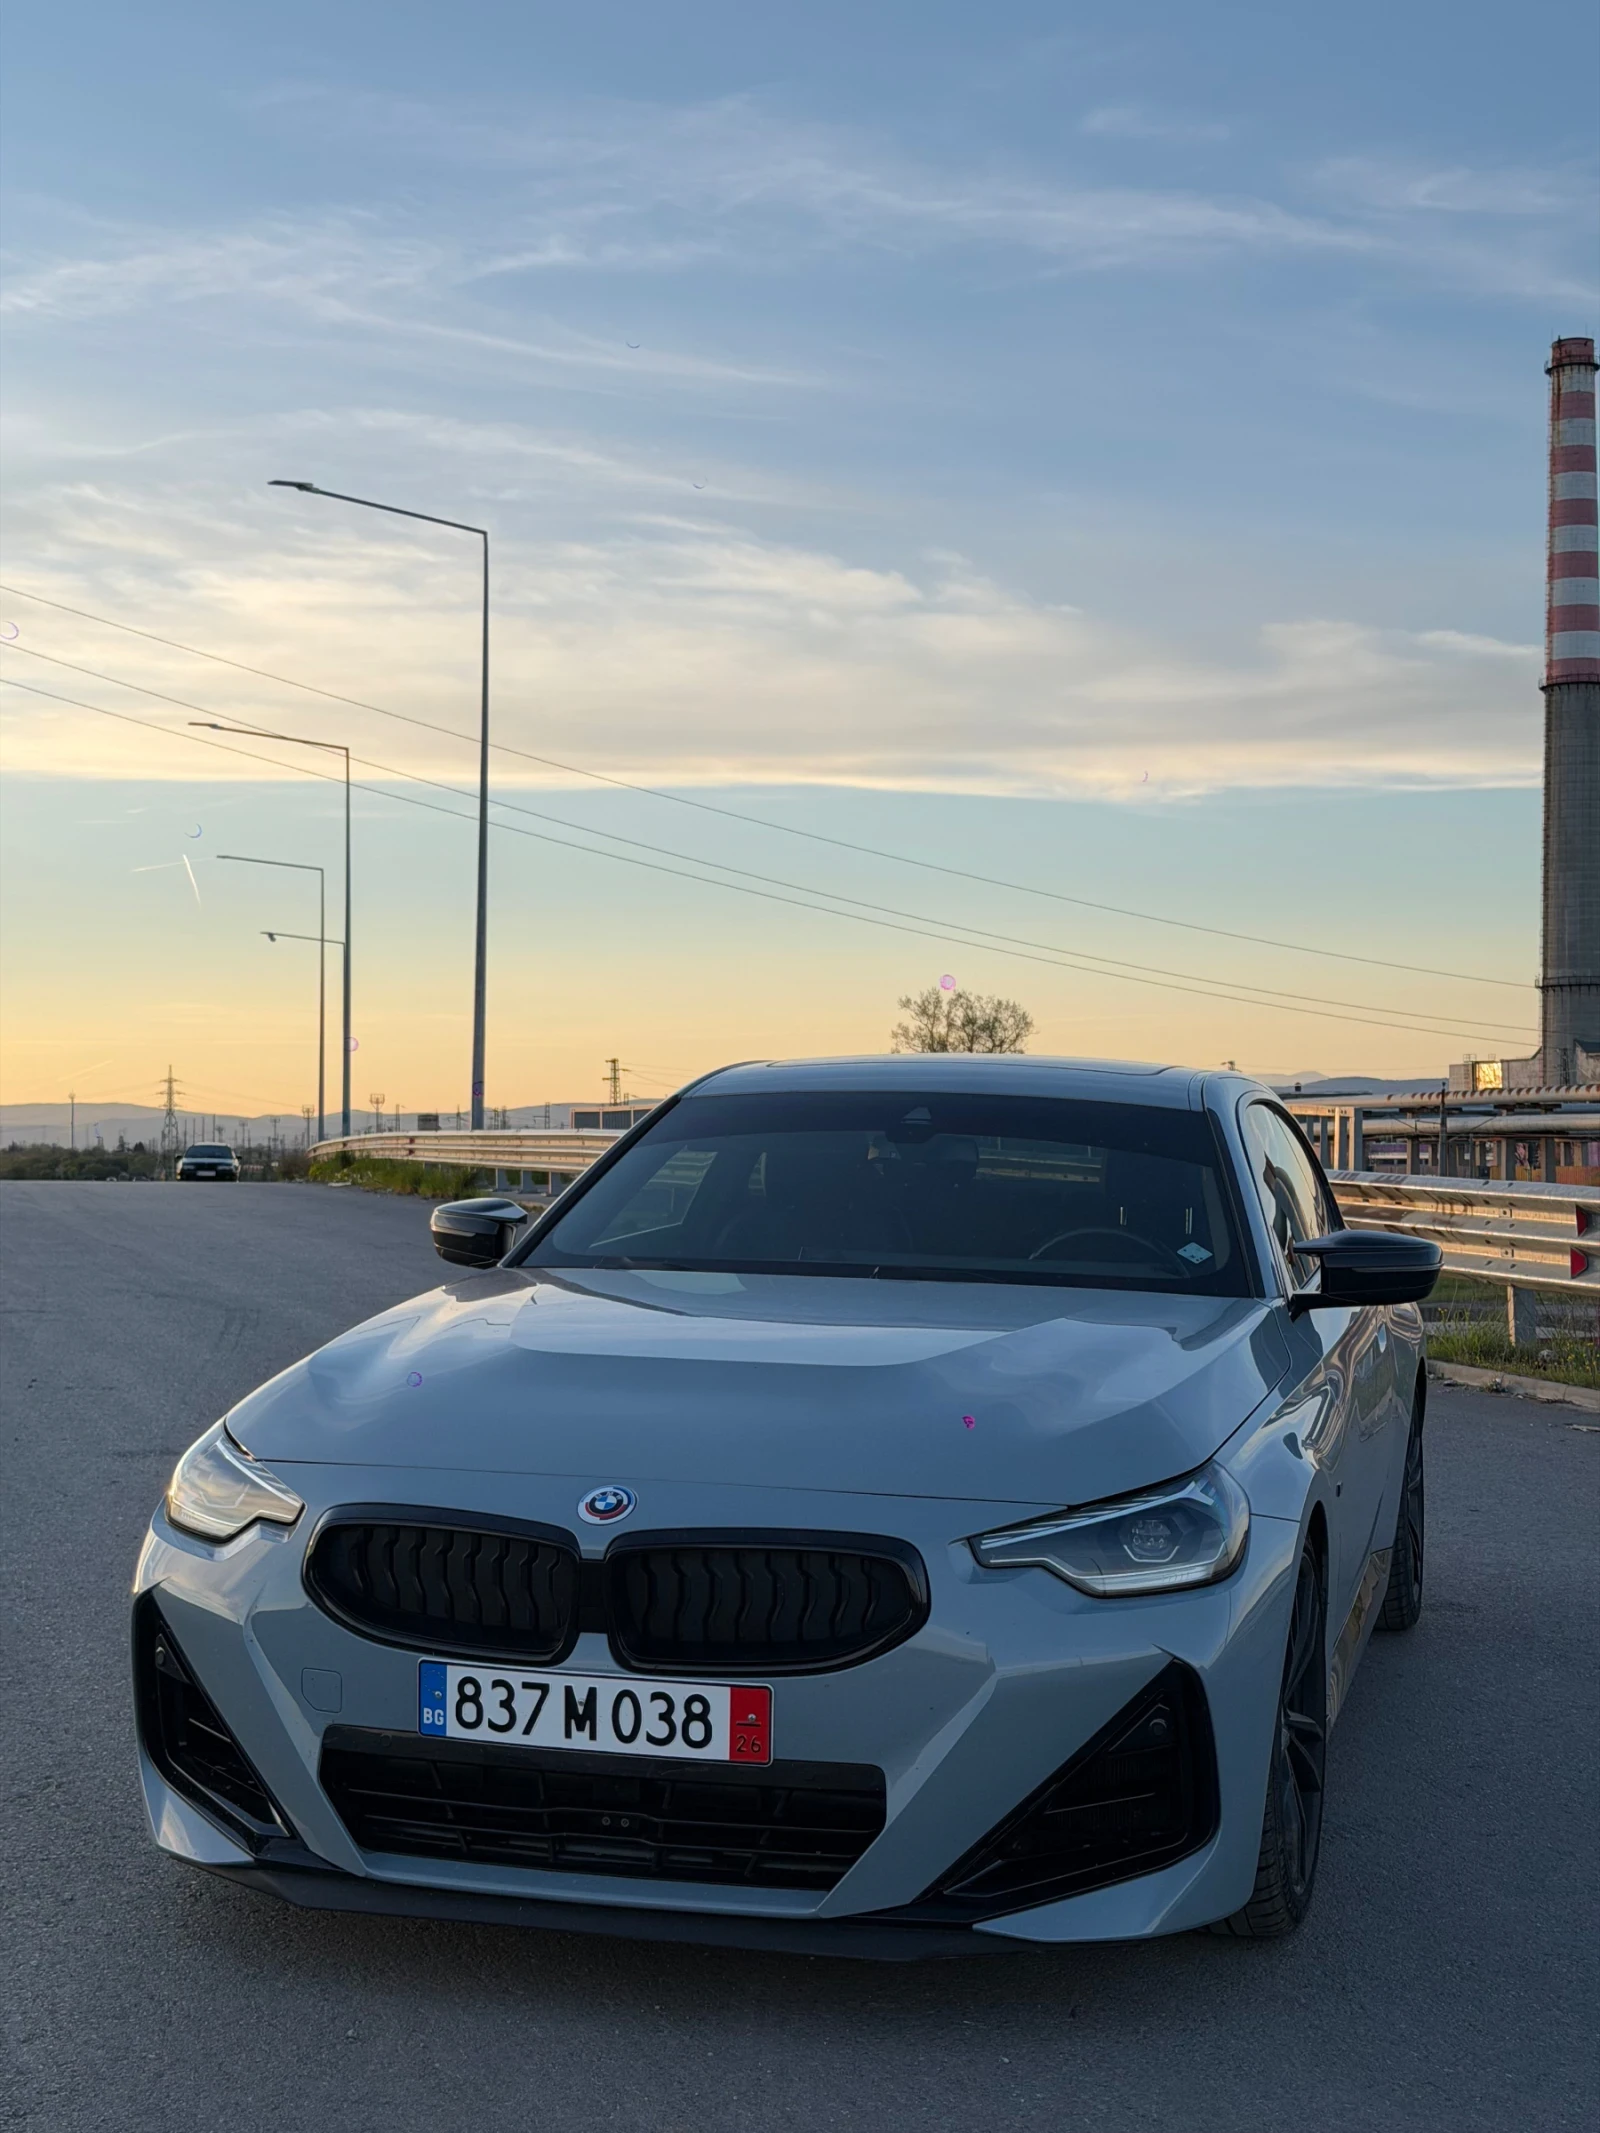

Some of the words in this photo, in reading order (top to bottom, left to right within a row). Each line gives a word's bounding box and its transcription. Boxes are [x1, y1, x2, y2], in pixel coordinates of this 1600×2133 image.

[423, 1707, 445, 1726] BG
[455, 1676, 550, 1735] 837
[564, 1685, 598, 1741] M
[612, 1689, 713, 1749] 038
[736, 1734, 762, 1754] 26
